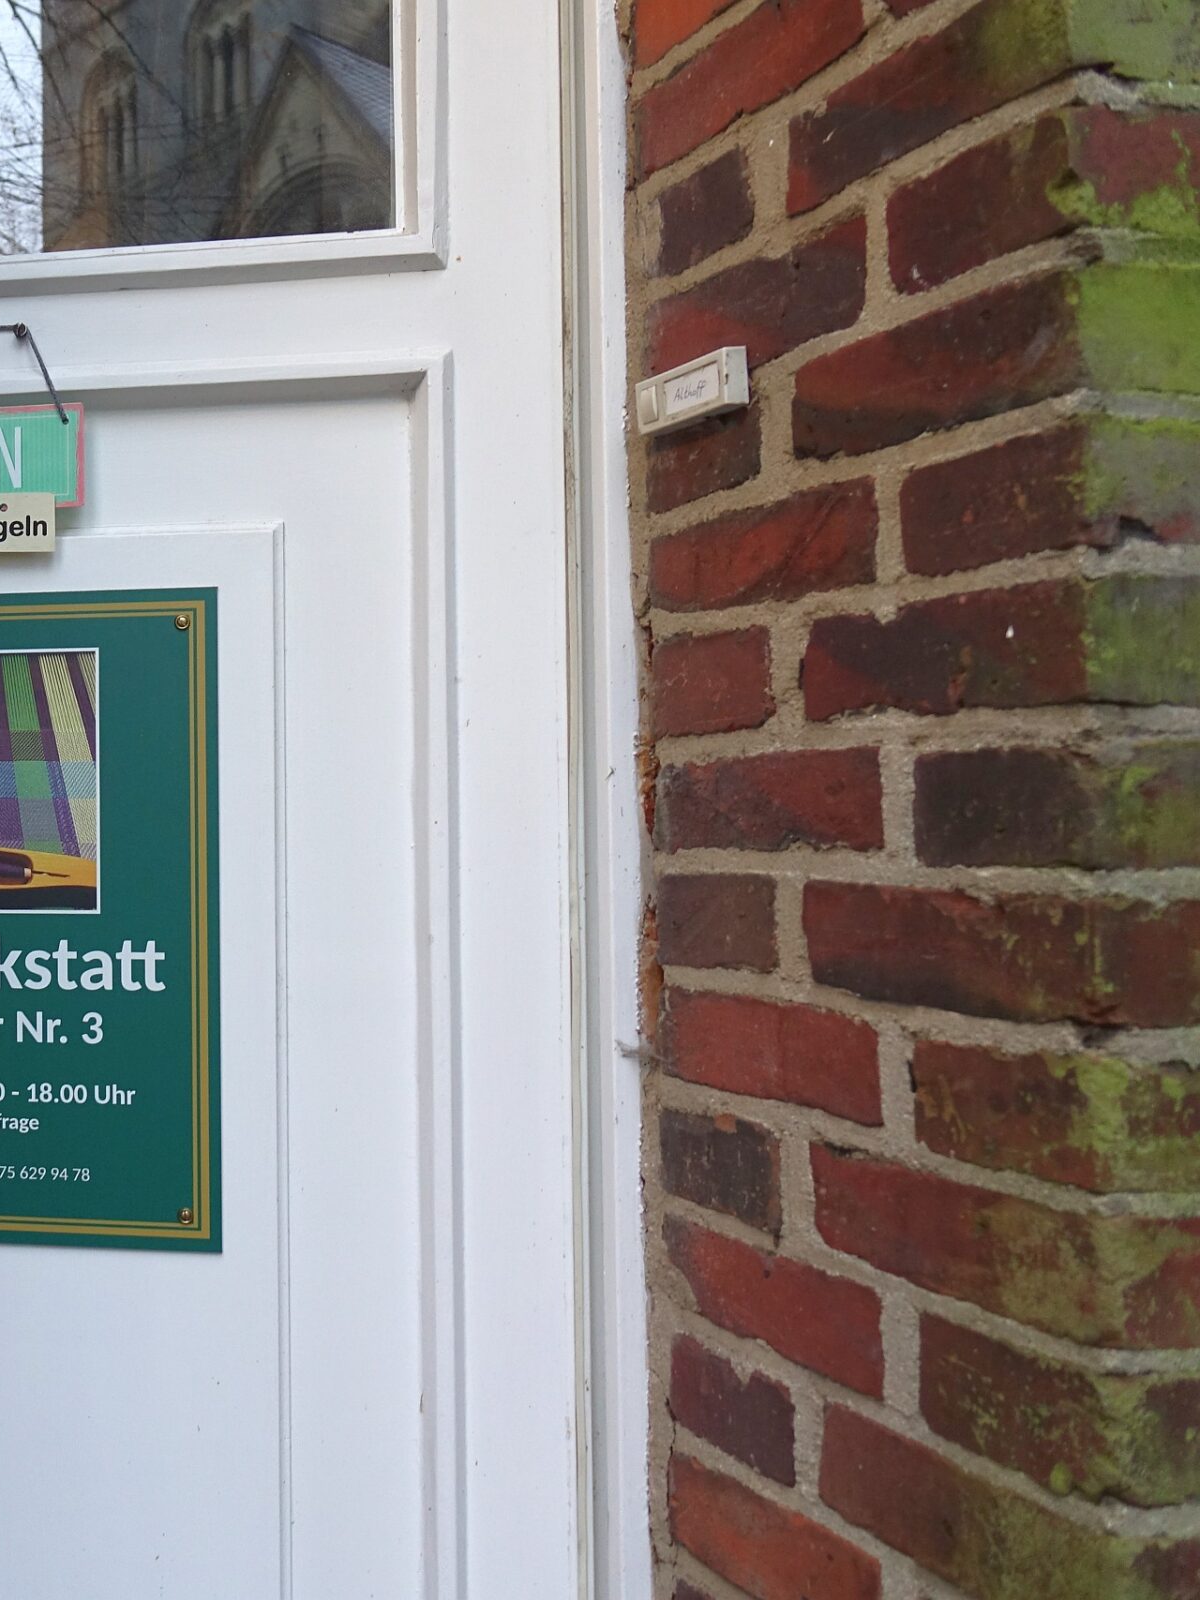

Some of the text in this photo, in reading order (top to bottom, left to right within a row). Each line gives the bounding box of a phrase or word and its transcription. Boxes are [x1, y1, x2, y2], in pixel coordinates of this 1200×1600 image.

[16, 1010, 68, 1044] Nr.
[81, 1011, 104, 1045] 3
[26, 1082, 88, 1104] 18.00
[94, 1083, 136, 1106] Uhr
[19, 1165, 47, 1181] 629
[50, 1167, 69, 1182] 94
[72, 1167, 91, 1183] 78
